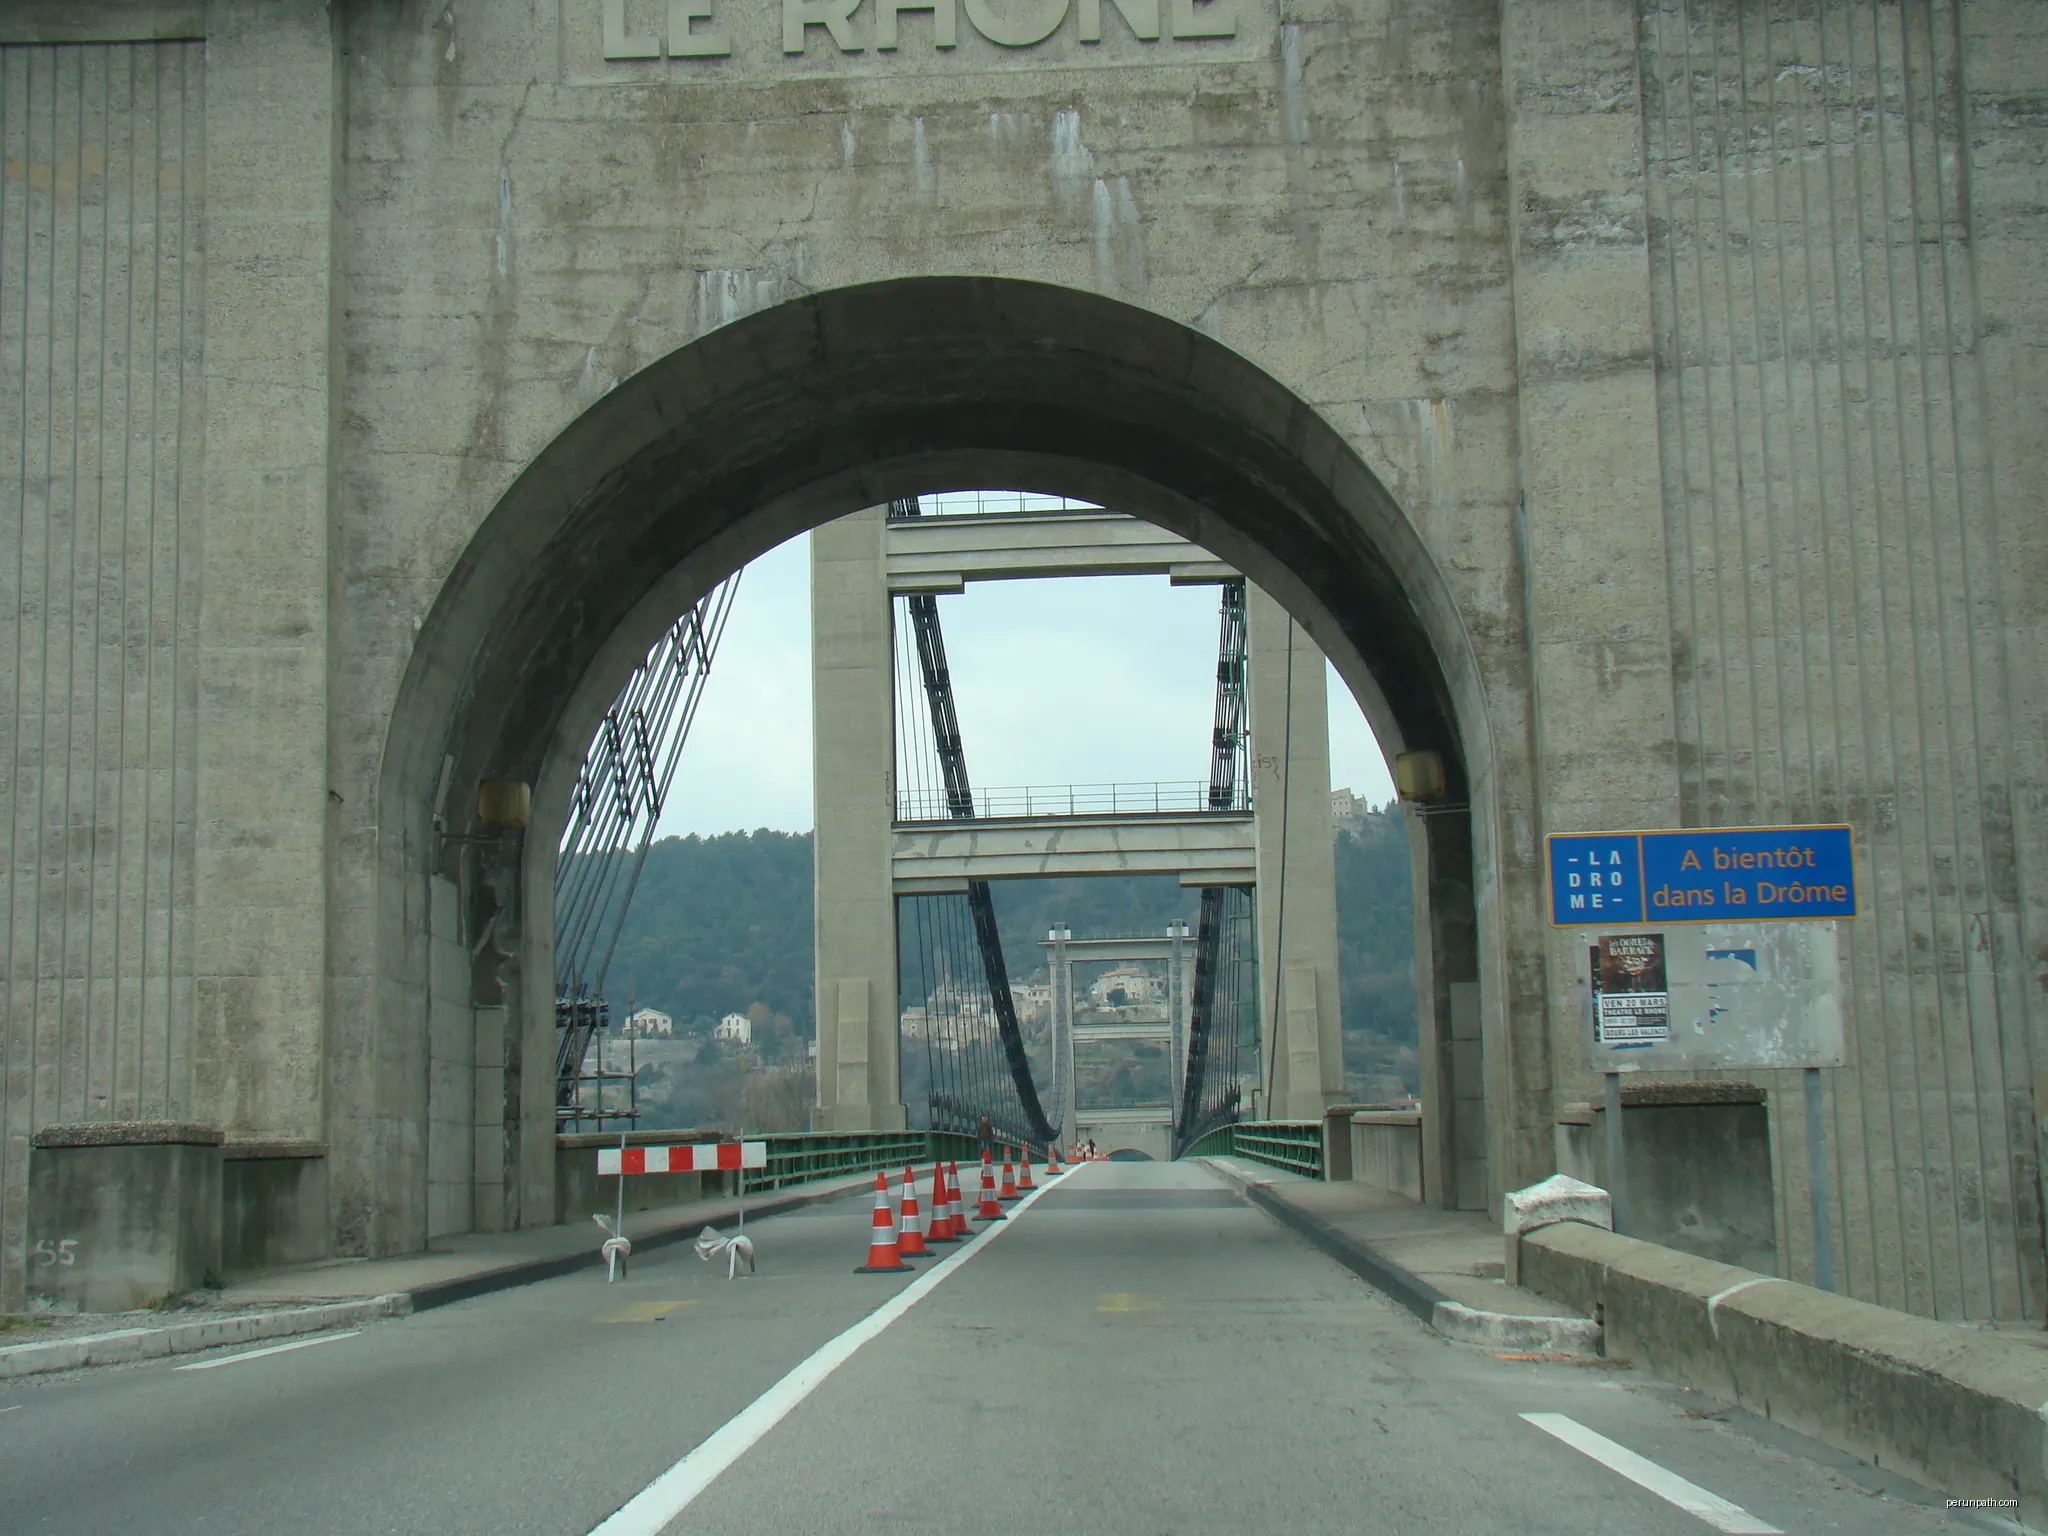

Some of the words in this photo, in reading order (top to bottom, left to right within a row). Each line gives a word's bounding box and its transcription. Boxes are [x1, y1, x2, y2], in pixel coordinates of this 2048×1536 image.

[604, 0, 731, 61] LE
[1680, 848, 1702, 872] A
[1713, 845, 1817, 871] bientôt
[1568, 871, 1623, 888] DRO
[1652, 884, 1716, 908] dans
[1724, 881, 1746, 905] la
[1757, 880, 1847, 905] Drôme
[1604, 999, 1623, 1008] VEN
[1626, 998, 1637, 1007] 20
